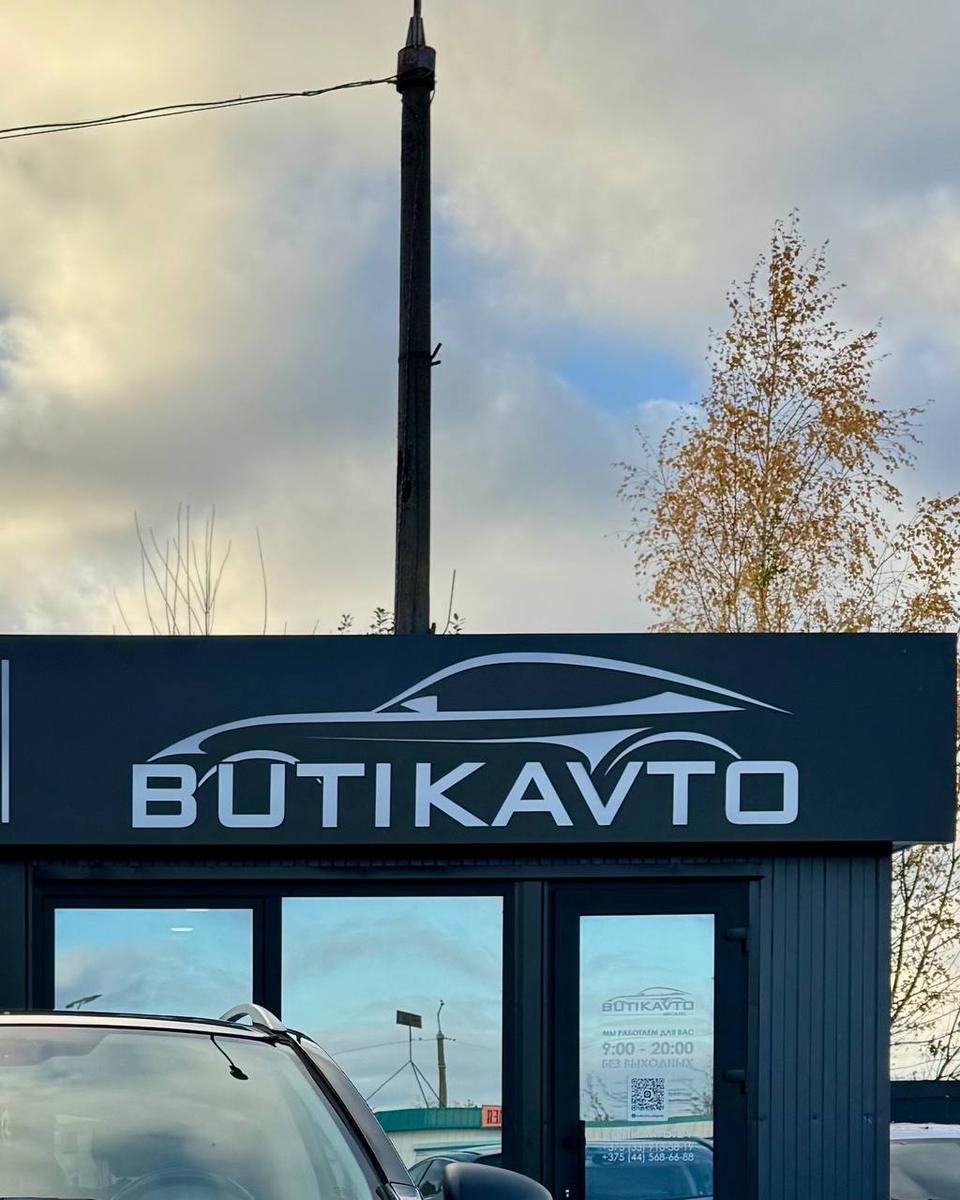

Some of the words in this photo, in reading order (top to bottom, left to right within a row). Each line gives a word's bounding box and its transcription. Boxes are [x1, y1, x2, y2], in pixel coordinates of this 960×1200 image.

[132, 759, 800, 829] BUTIKAVTO
[602, 1001, 694, 1012] BUTIKAVTO
[602, 1042, 634, 1056] 9:00
[651, 1041, 694, 1055] 20:00
[602, 1153, 625, 1162] +375
[628, 1152, 646, 1164] (44)
[648, 1153, 695, 1162] 568-66-88
